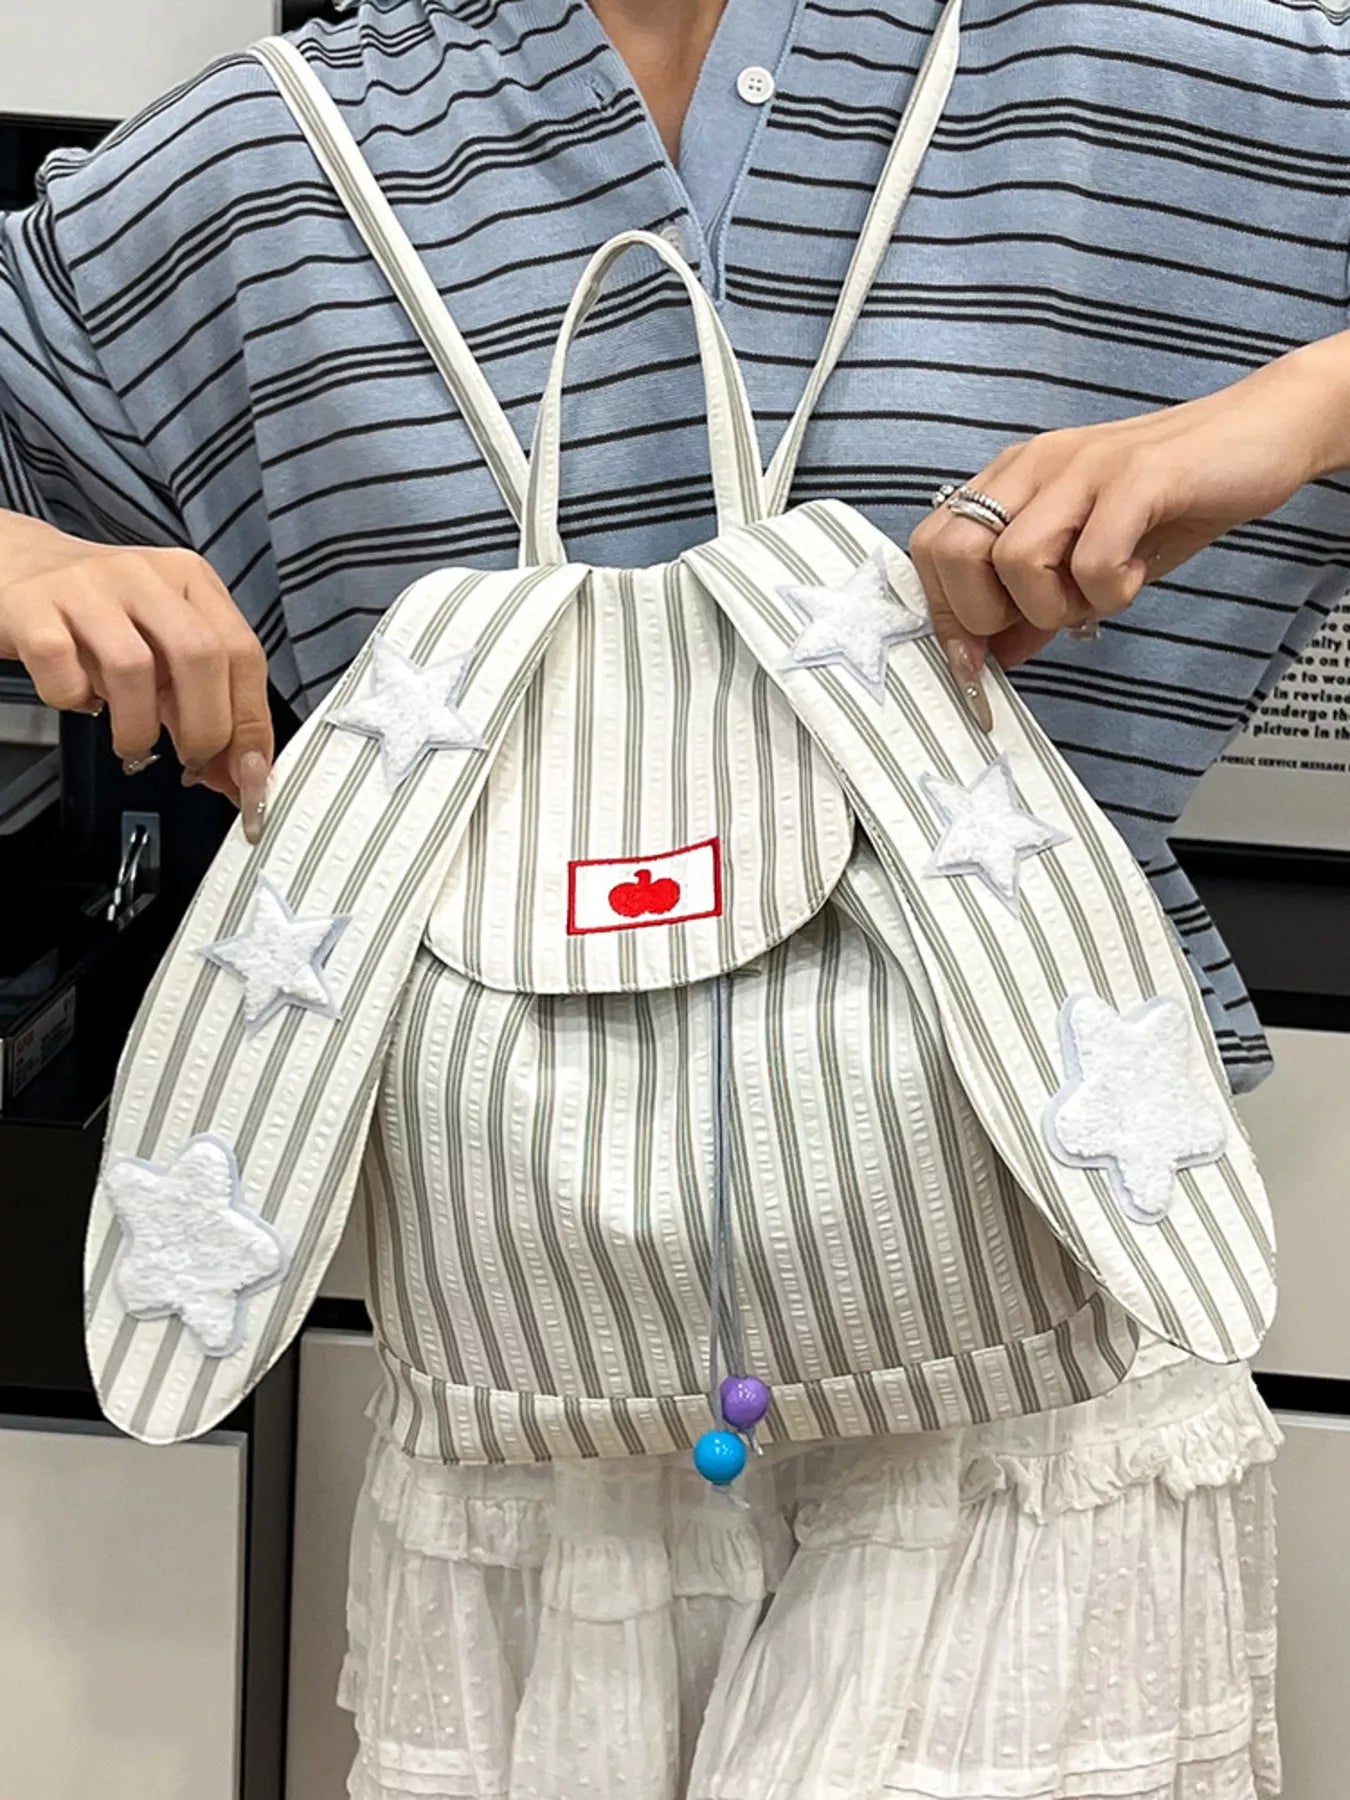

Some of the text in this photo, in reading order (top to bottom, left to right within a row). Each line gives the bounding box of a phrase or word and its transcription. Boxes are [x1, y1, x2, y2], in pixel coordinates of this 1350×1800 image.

[1306, 636, 1342, 653] nity
[1319, 657, 1339, 667] on
[1302, 671, 1318, 683] to
[1274, 686, 1289, 699] in
[1260, 704, 1350, 722] undergo th
[1253, 721, 1310, 738] picture
[1314, 725, 1330, 738] in
[1258, 758, 1298, 769] SERVICE
[1300, 761, 1346, 772] MESSAGE
